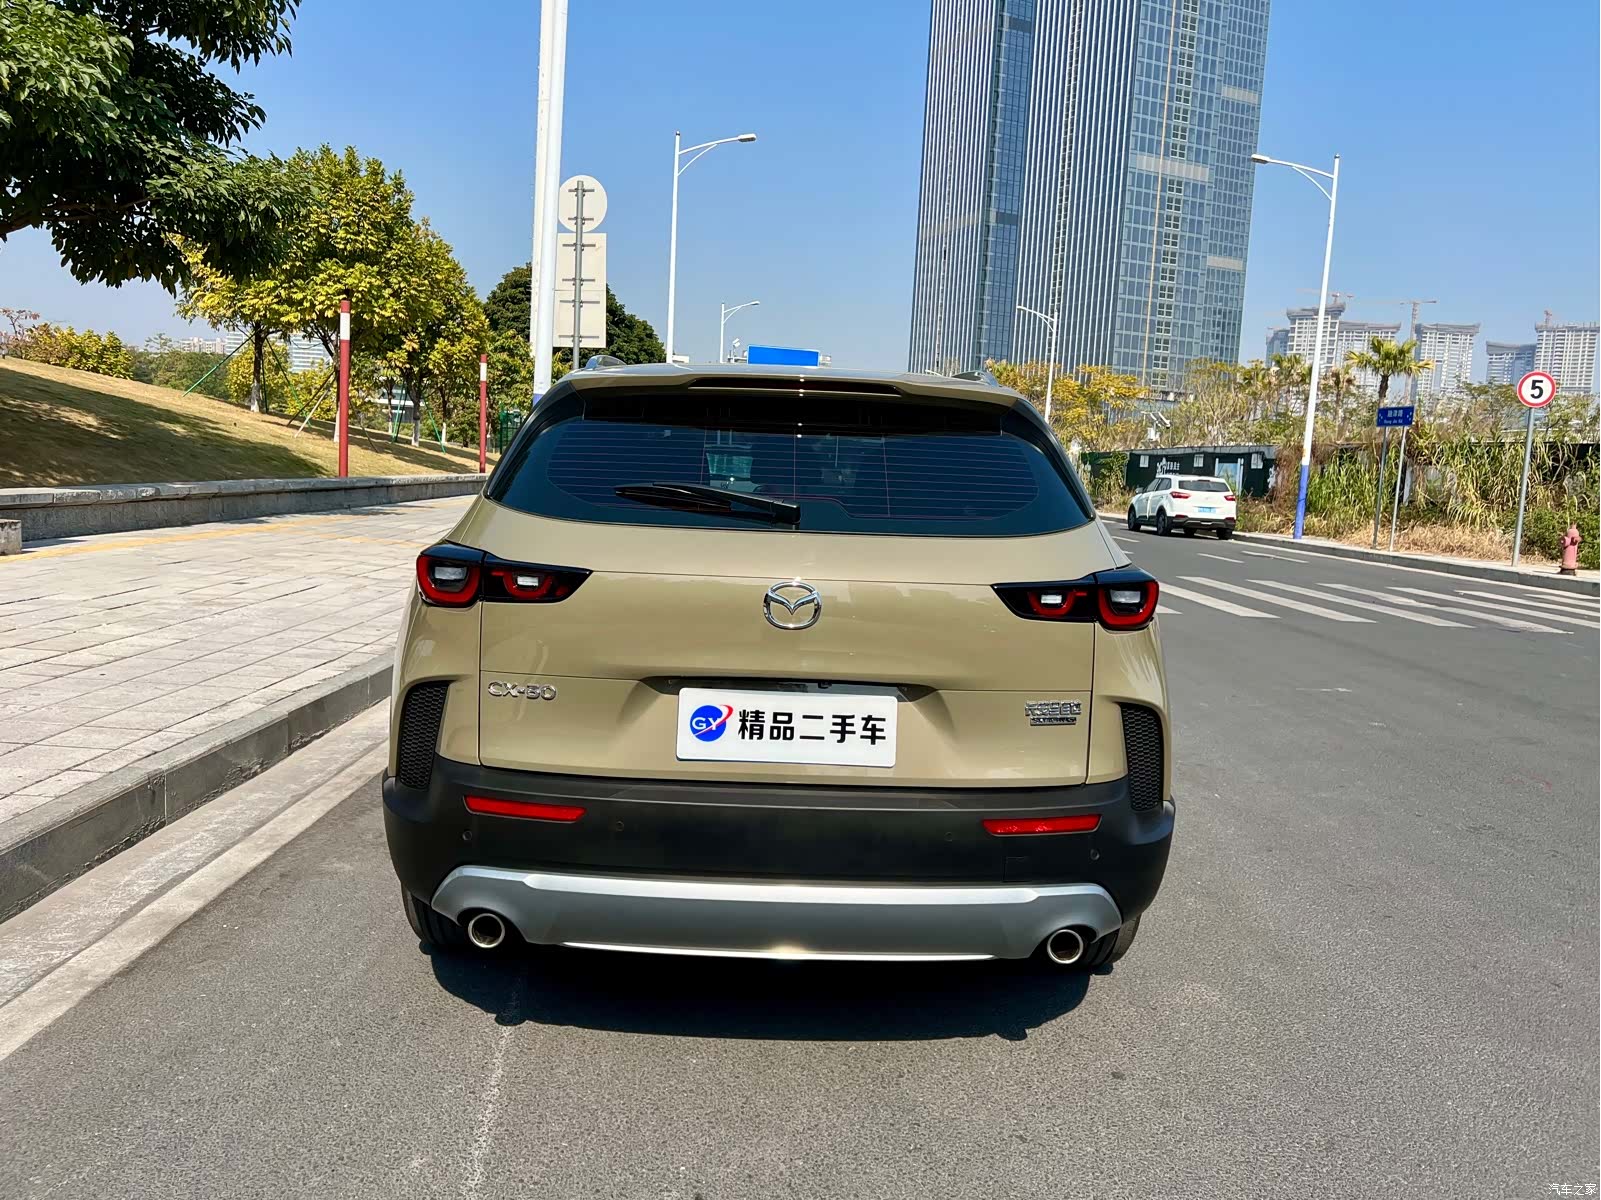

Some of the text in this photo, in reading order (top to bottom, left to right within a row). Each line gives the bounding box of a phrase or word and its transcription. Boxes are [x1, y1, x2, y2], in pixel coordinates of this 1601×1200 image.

[1530, 379, 1544, 399] 5
[488, 681, 557, 701] CX-50
[691, 716, 722, 731] GY
[737, 709, 887, 746] 精品二手车
